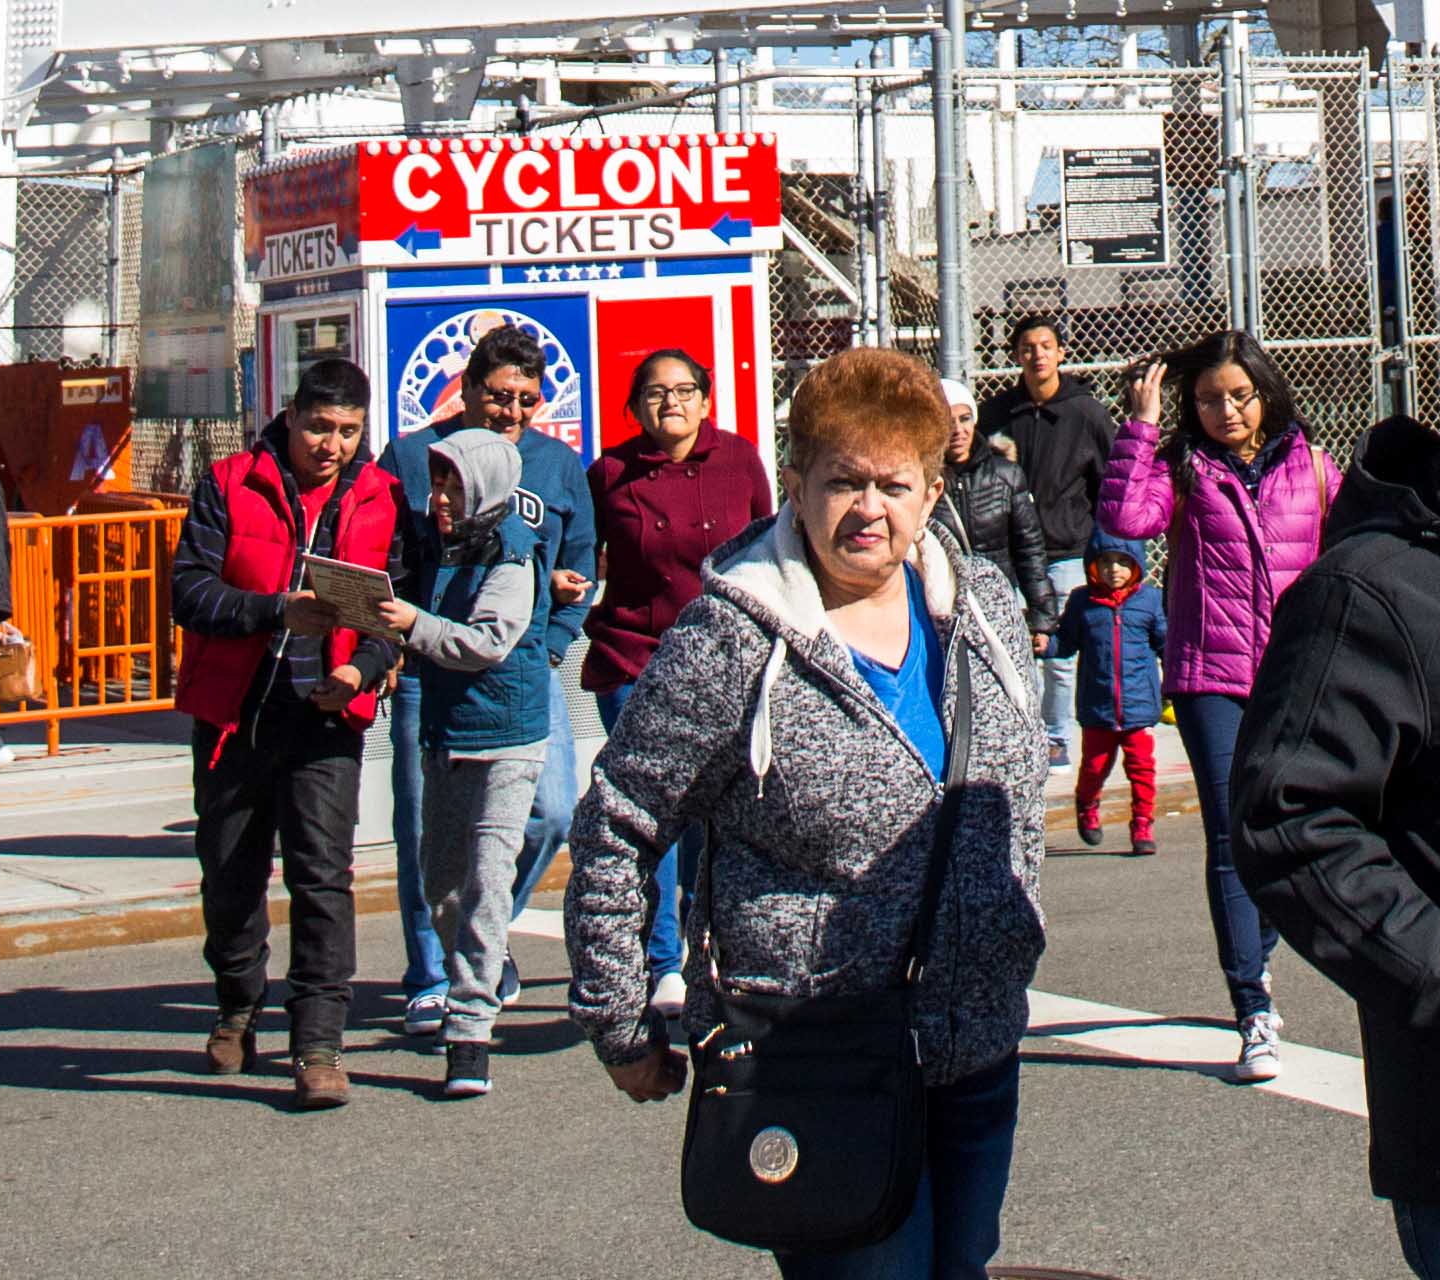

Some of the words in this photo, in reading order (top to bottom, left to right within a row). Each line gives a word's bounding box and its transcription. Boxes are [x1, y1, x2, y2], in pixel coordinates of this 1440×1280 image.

[391, 146, 751, 211] CYCLONE
[265, 226, 338, 277] TICKETS
[476, 214, 676, 257] TICKETS
